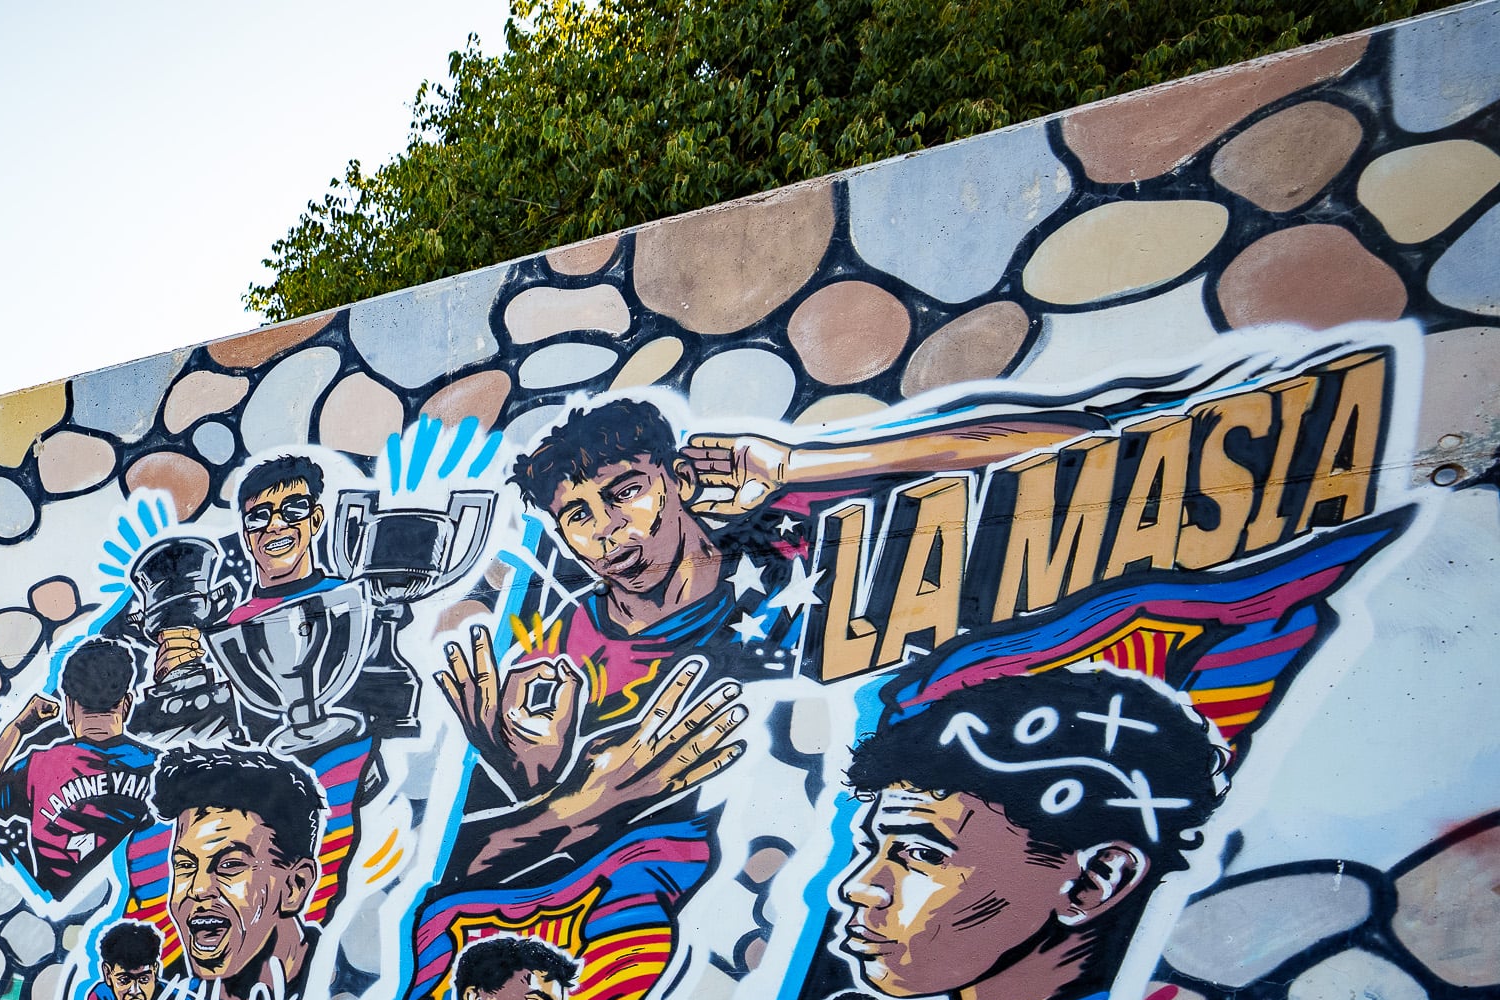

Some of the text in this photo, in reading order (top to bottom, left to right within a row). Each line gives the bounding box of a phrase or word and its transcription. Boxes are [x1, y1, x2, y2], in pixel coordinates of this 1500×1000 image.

[819, 350, 1388, 684] LA MASIA
[40, 773, 109, 823] LAMINE
